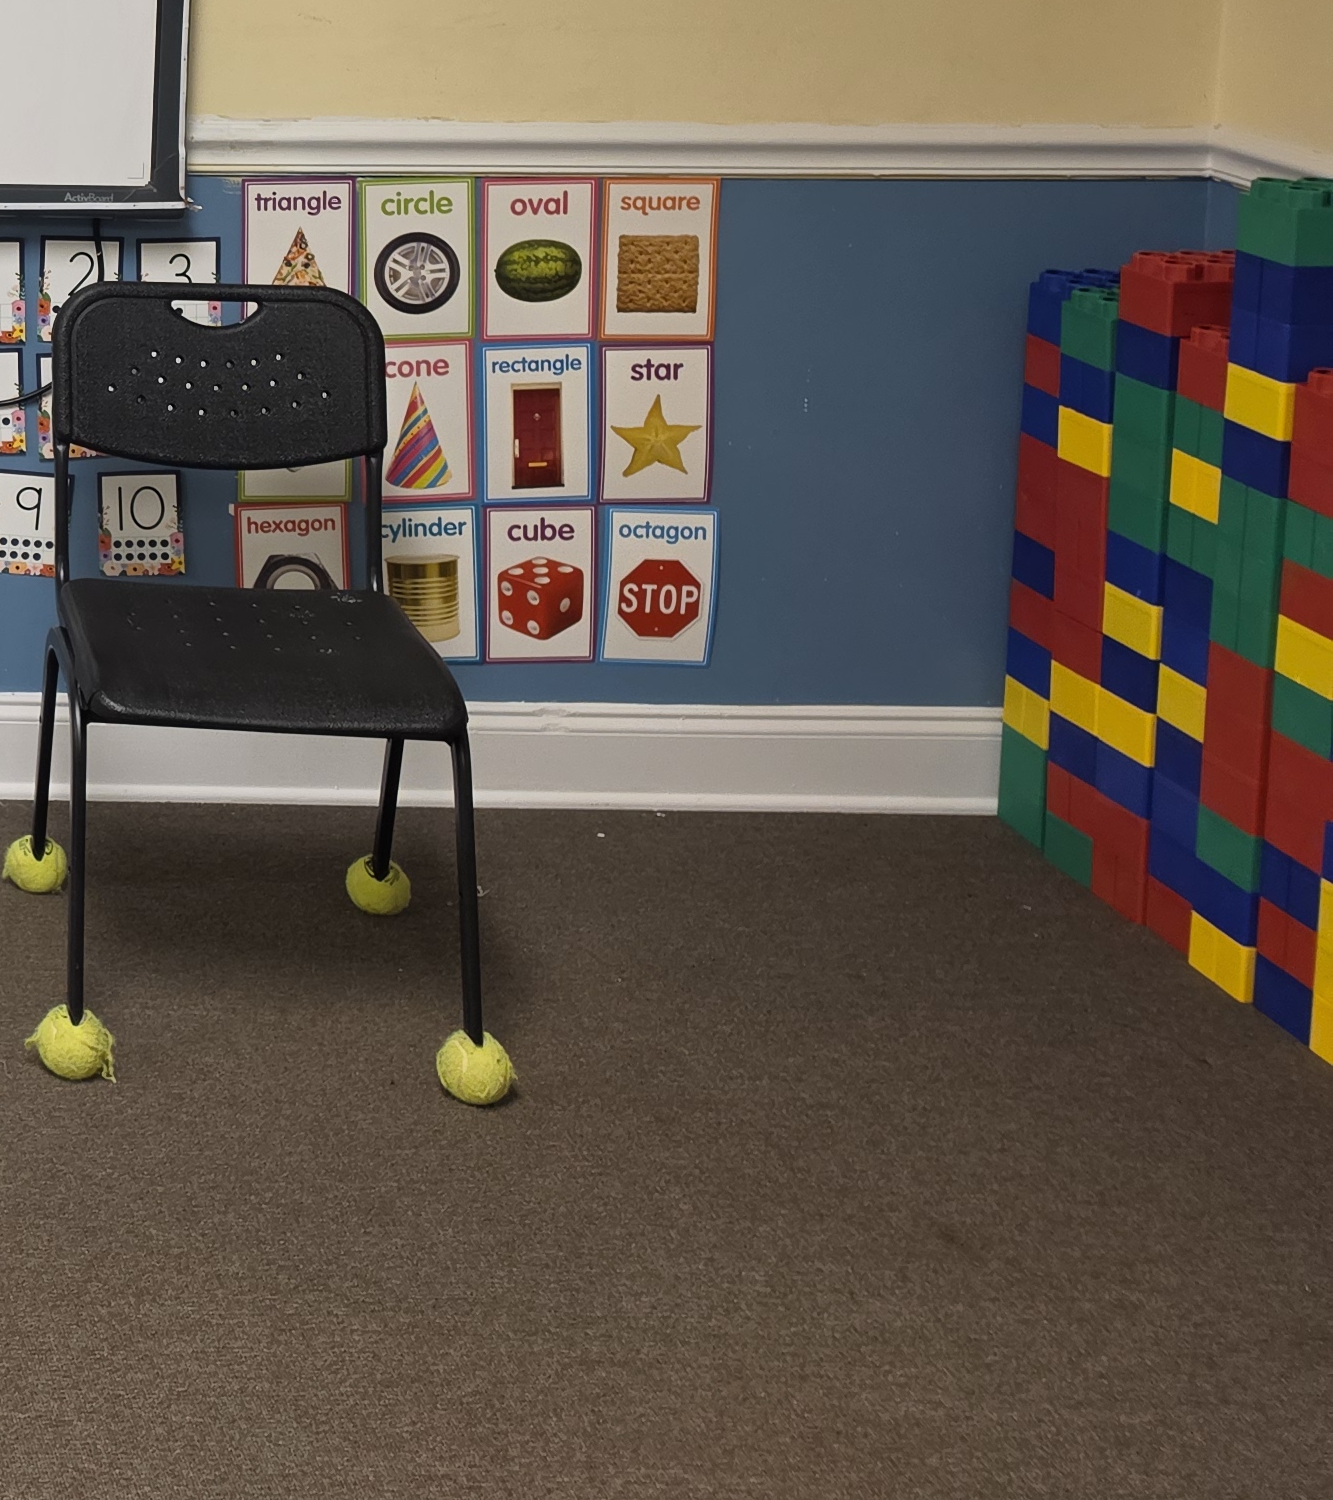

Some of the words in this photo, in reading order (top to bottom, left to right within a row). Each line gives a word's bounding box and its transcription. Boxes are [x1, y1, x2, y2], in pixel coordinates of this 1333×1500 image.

[64, 192, 114, 202] ActivBoard
[254, 191, 342, 216] triangle
[380, 192, 454, 216] circle
[510, 191, 569, 216] oval
[620, 194, 701, 217] square
[386, 357, 450, 378] cone
[491, 355, 583, 378] rectangle
[630, 360, 684, 382] star
[16, 486, 43, 531] 9
[117, 485, 165, 531] 10
[246, 515, 336, 537] hexagon
[507, 519, 575, 543] cube
[618, 522, 707, 545] octagon
[621, 583, 699, 616] STOP
